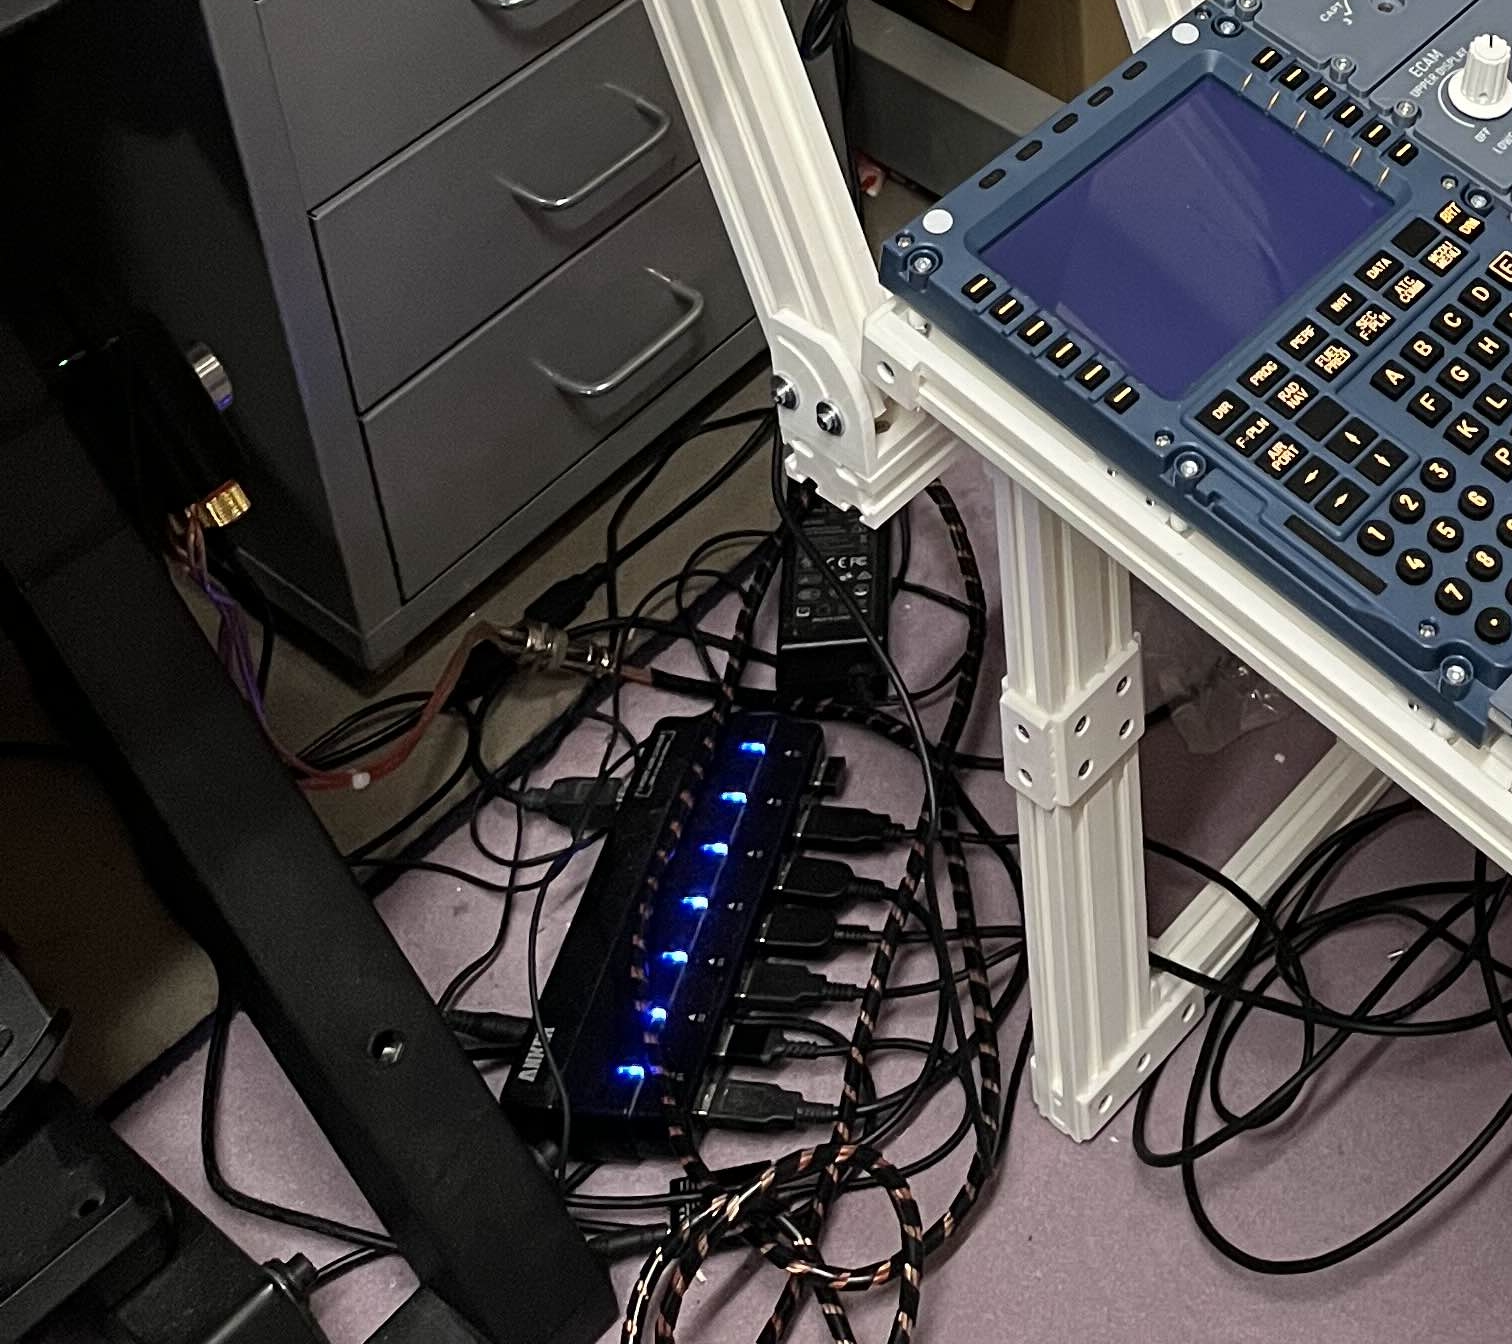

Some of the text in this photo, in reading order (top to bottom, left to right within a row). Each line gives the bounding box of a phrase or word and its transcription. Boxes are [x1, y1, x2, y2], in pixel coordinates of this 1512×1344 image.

[1320, 1, 1343, 22] CAPT
[1408, 49, 1444, 78] ECAM
[1366, 258, 1393, 280] DATA
[1290, 324, 1316, 350] PERF
[1250, 360, 1278, 386] PROG
[1212, 400, 1234, 420] DIR
